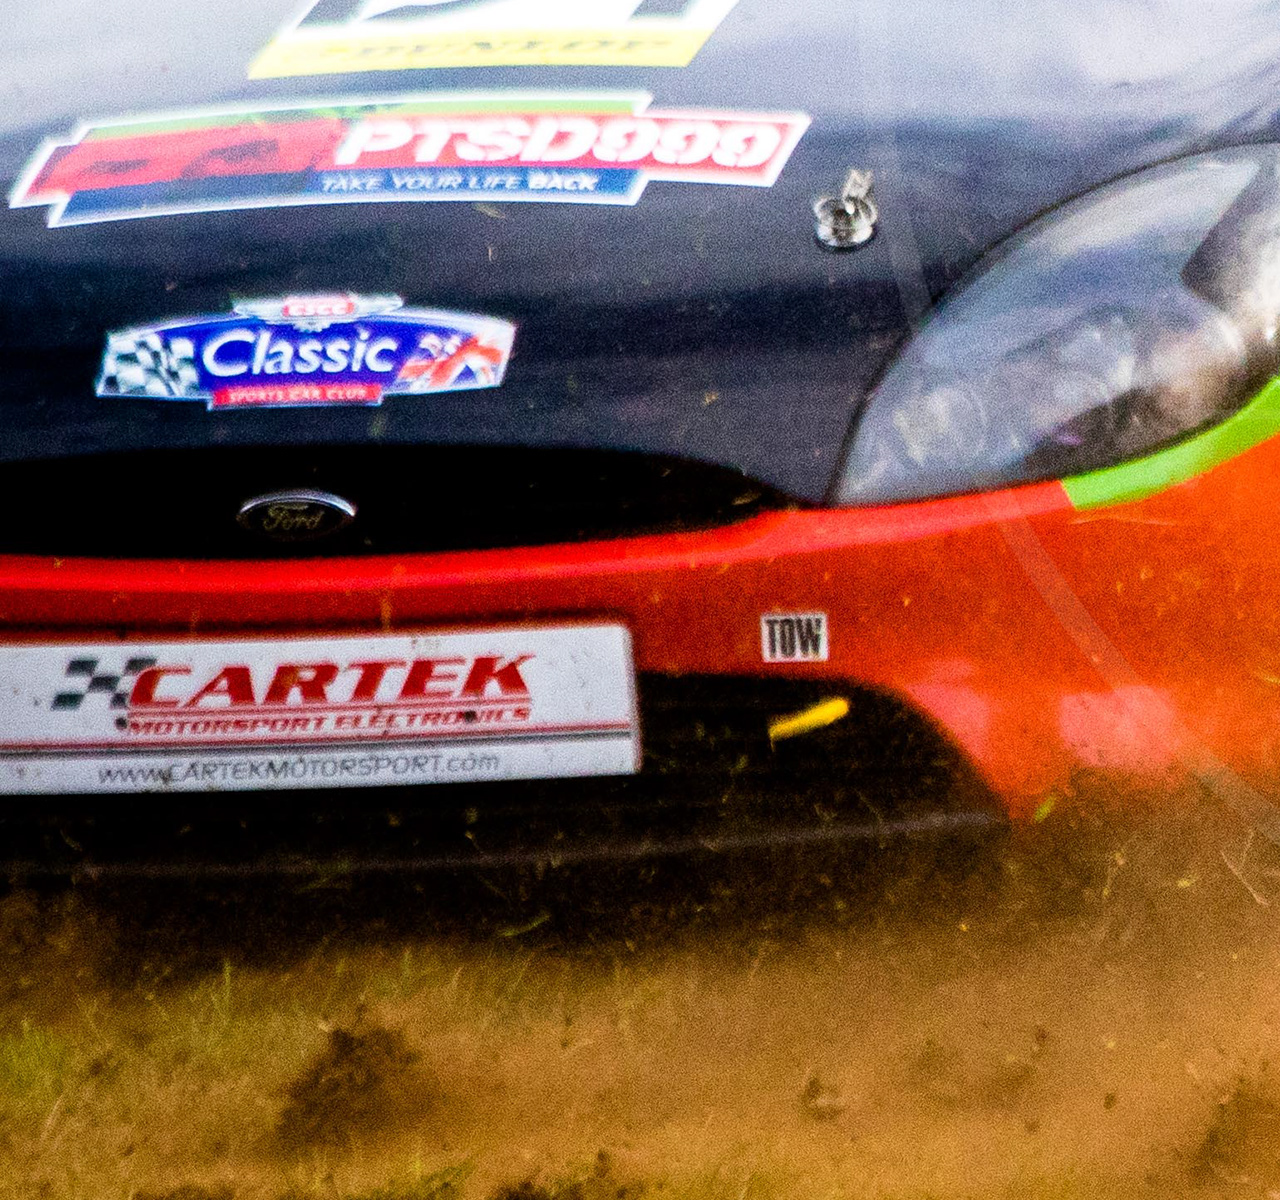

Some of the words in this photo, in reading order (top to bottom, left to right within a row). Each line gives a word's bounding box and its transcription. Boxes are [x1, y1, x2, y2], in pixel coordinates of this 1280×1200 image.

[334, 117, 782, 167] PTSD999
[320, 175, 384, 193] TAKE
[389, 172, 463, 190] YOUR
[467, 174, 522, 191] LIFE
[526, 173, 599, 191] BACK
[202, 327, 399, 378] Classic
[229, 388, 284, 402] SPORTS
[288, 387, 321, 401] CAR
[325, 386, 367, 400] CLUB
[262, 503, 326, 532] Ford
[763, 616, 822, 657] TOW
[129, 653, 537, 709] CARTEK
[127, 714, 328, 737] MOTORSPORT
[98, 753, 501, 787] wwwCARTEKMOTORSPORT.com
